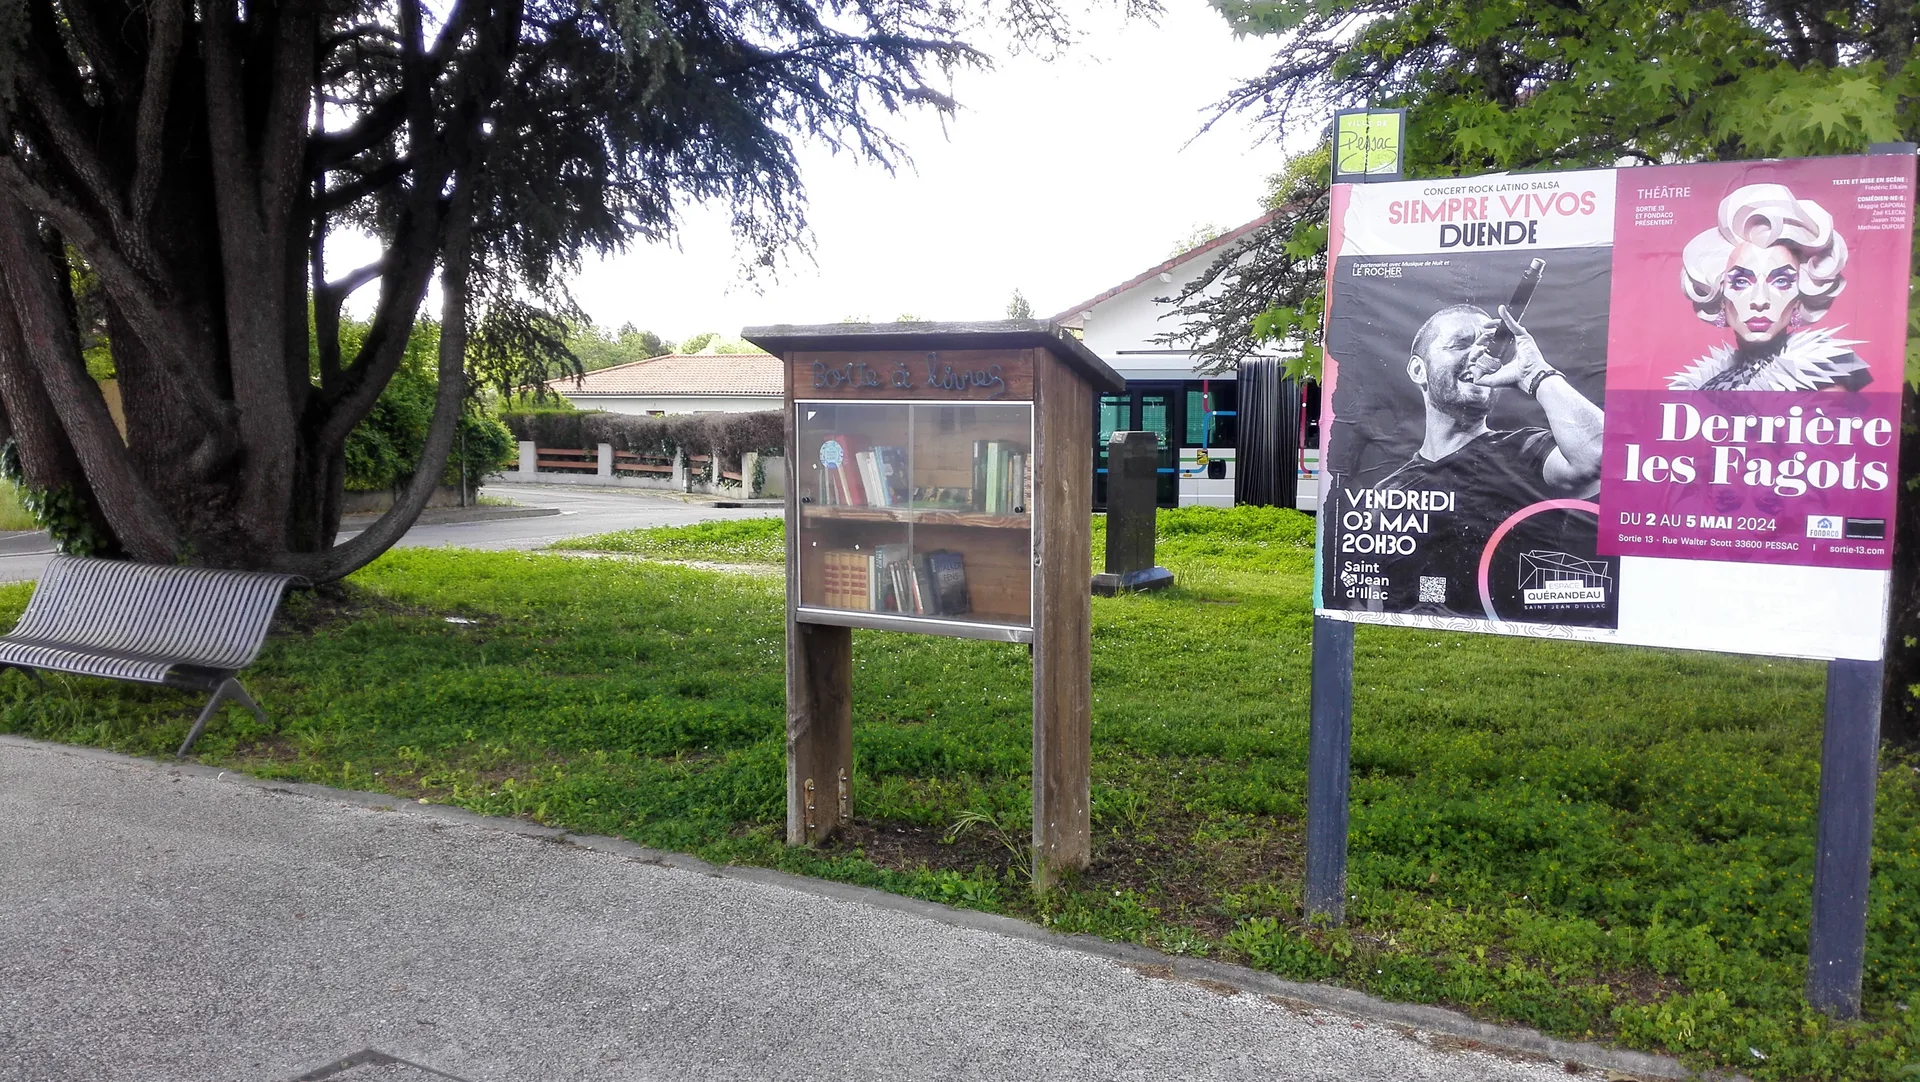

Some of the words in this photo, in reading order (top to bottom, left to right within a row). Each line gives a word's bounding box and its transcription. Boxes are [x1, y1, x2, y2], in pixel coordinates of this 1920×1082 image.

[1339, 131, 1397, 152] Pessac
[1424, 187, 1466, 196] CONCERT
[1469, 185, 1494, 193] ROCK
[1496, 182, 1529, 192] LATINO
[1531, 181, 1560, 190] SALSA
[1637, 185, 1691, 199] THÉÂTRE
[1389, 196, 1488, 225] SIEMPRE
[1499, 191, 1596, 218] VIVOS
[1635, 218, 1674, 226] PRÉSENTENT
[1440, 220, 1537, 248] DUENDE
[1352, 268, 1362, 276] LE
[1364, 267, 1402, 276] ROCHER
[1401, 260, 1423, 268] Musique
[891, 360, 914, 388] à
[925, 351, 1006, 400] livres
[1656, 402, 1892, 447] Derrière
[1622, 443, 1697, 484] les
[1708, 446, 1889, 497] Fagots
[1344, 489, 1455, 512] VENDREDI
[1343, 510, 1373, 531] 03
[1380, 512, 1428, 534] MAI
[1620, 512, 1642, 526] DU
[1645, 513, 1657, 527] 2
[1660, 514, 1681, 527] AU
[1686, 515, 1697, 529] 5
[1700, 515, 1733, 530] MAI
[1737, 517, 1777, 531] 2024
[1810, 529, 1839, 537] FONDACO
[1342, 533, 1417, 555] 20H30
[1618, 534, 1642, 543] Sortie
[1645, 535, 1654, 543] 13
[1662, 536, 1678, 545] Rue
[1680, 537, 1707, 547] Walter
[1710, 538, 1732, 547] Scott
[1734, 540, 1762, 549] 33600
[1765, 541, 1799, 551] PESSAC
[1829, 546, 1885, 555] sortie-13.com
[1344, 560, 1380, 574] Saint
[1358, 575, 1390, 587] Jean
[1549, 582, 1580, 590] ESPACE
[1346, 586, 1389, 600] d'Illac
[1527, 590, 1601, 600] QUÉRANDEAU
